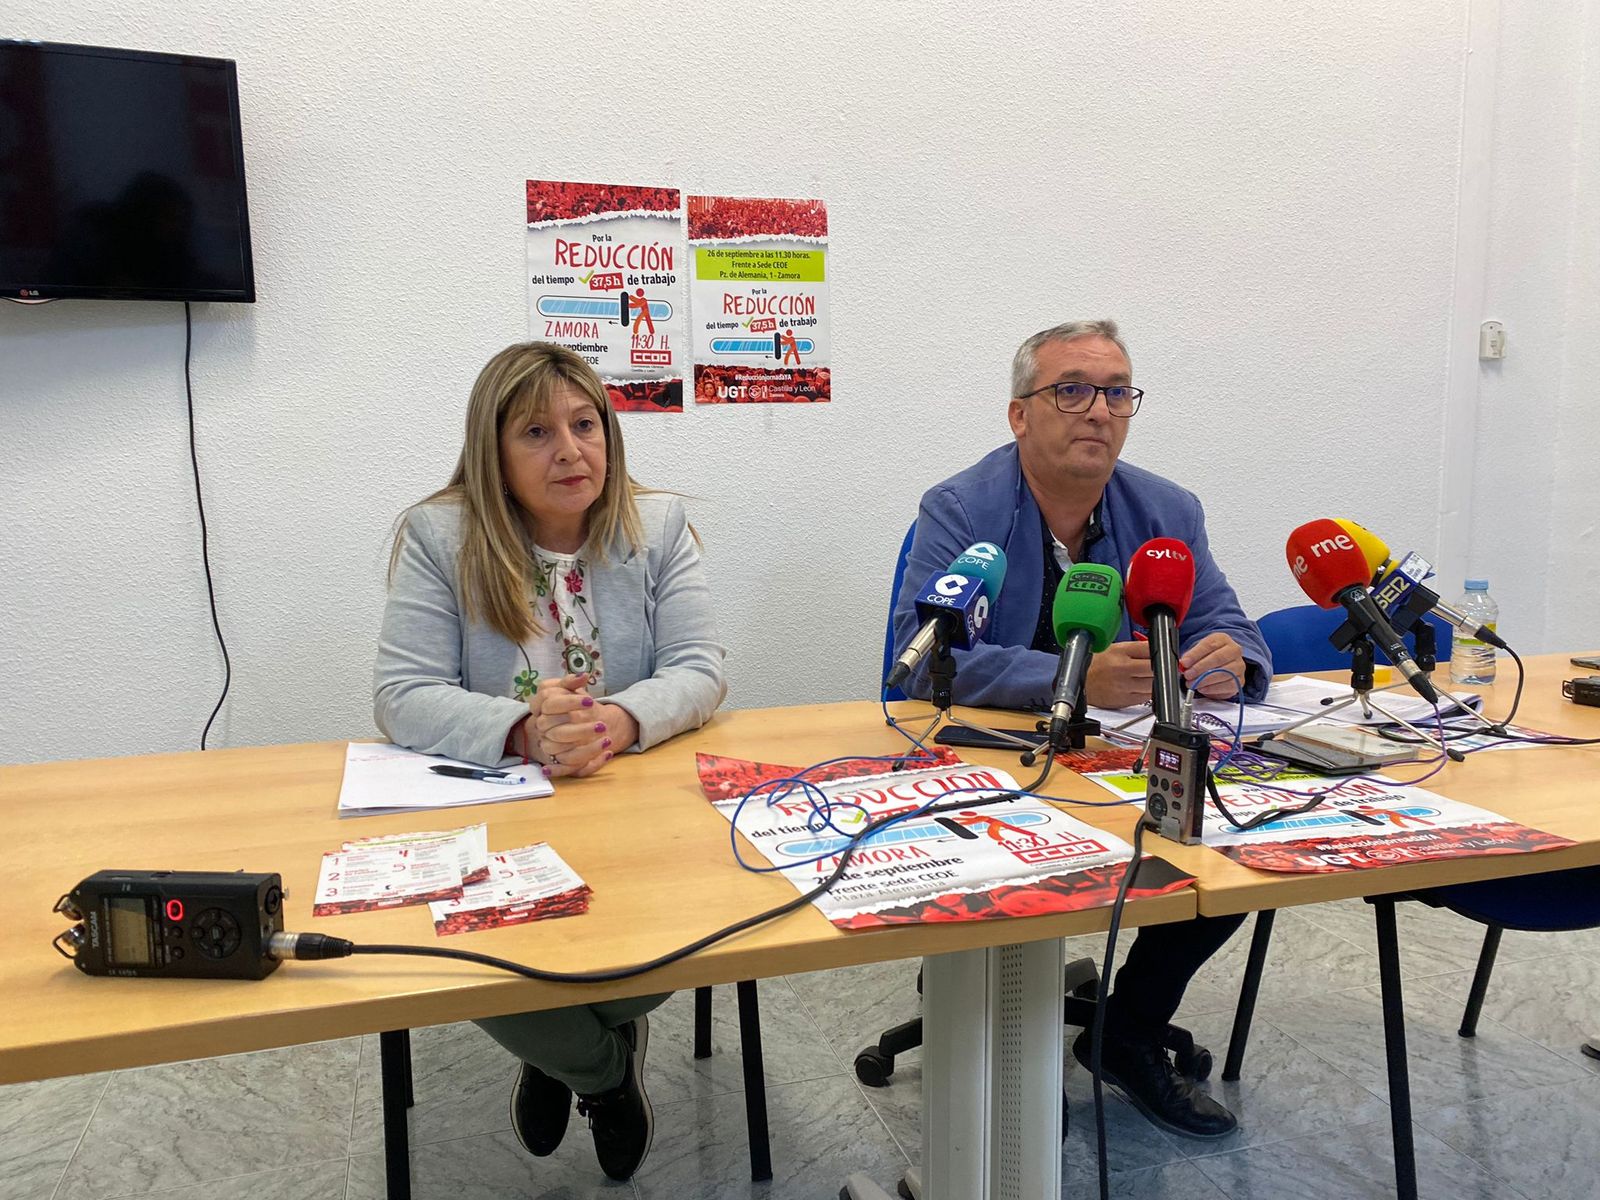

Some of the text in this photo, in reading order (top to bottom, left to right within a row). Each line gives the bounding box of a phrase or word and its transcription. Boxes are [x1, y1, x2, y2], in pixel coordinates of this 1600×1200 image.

[592, 234, 612, 243] Por la
[555, 238, 674, 271] REDUCCIÓN
[707, 249, 716, 257] 26
[716, 249, 725, 257] de
[725, 249, 760, 259] septiembre
[765, 251, 774, 259] las
[775, 251, 792, 259] 11.30
[792, 251, 811, 259] horas.
[731, 261, 752, 269] Frente
[757, 261, 772, 269] Sede
[532, 273, 676, 288] del tiempo 37,5 h de trabajo
[738, 271, 769, 280] Alemania,
[723, 293, 815, 315] REDUCCIÓN
[545, 320, 599, 339] ZAMORA
[705, 321, 716, 330] del
[717, 321, 739, 330] tiempo
[768, 320, 775, 328] h
[779, 318, 789, 328] de
[790, 316, 818, 327] trabajo
[631, 334, 655, 349] 11:30
[632, 352, 670, 363] CCOO
[717, 386, 748, 399] UGT
[1310, 534, 1355, 557] rne
[957, 556, 990, 571] COPE
[1073, 582, 1104, 590] CERO
[926, 594, 957, 606] COPE
[751, 826, 777, 838] del
[998, 836, 1049, 851] 11:30
[1017, 841, 1104, 862] CCOO
[1295, 852, 1371, 867] UGT
[328, 872, 340, 881] 2
[842, 872, 863, 884] de
[864, 856, 965, 880] septiembre
[880, 876, 916, 888] sede
[915, 869, 960, 884] CEOE
[325, 888, 338, 897] 3
[833, 880, 947, 902] Plaza Alemania
[90, 911, 99, 948] TASCAM
